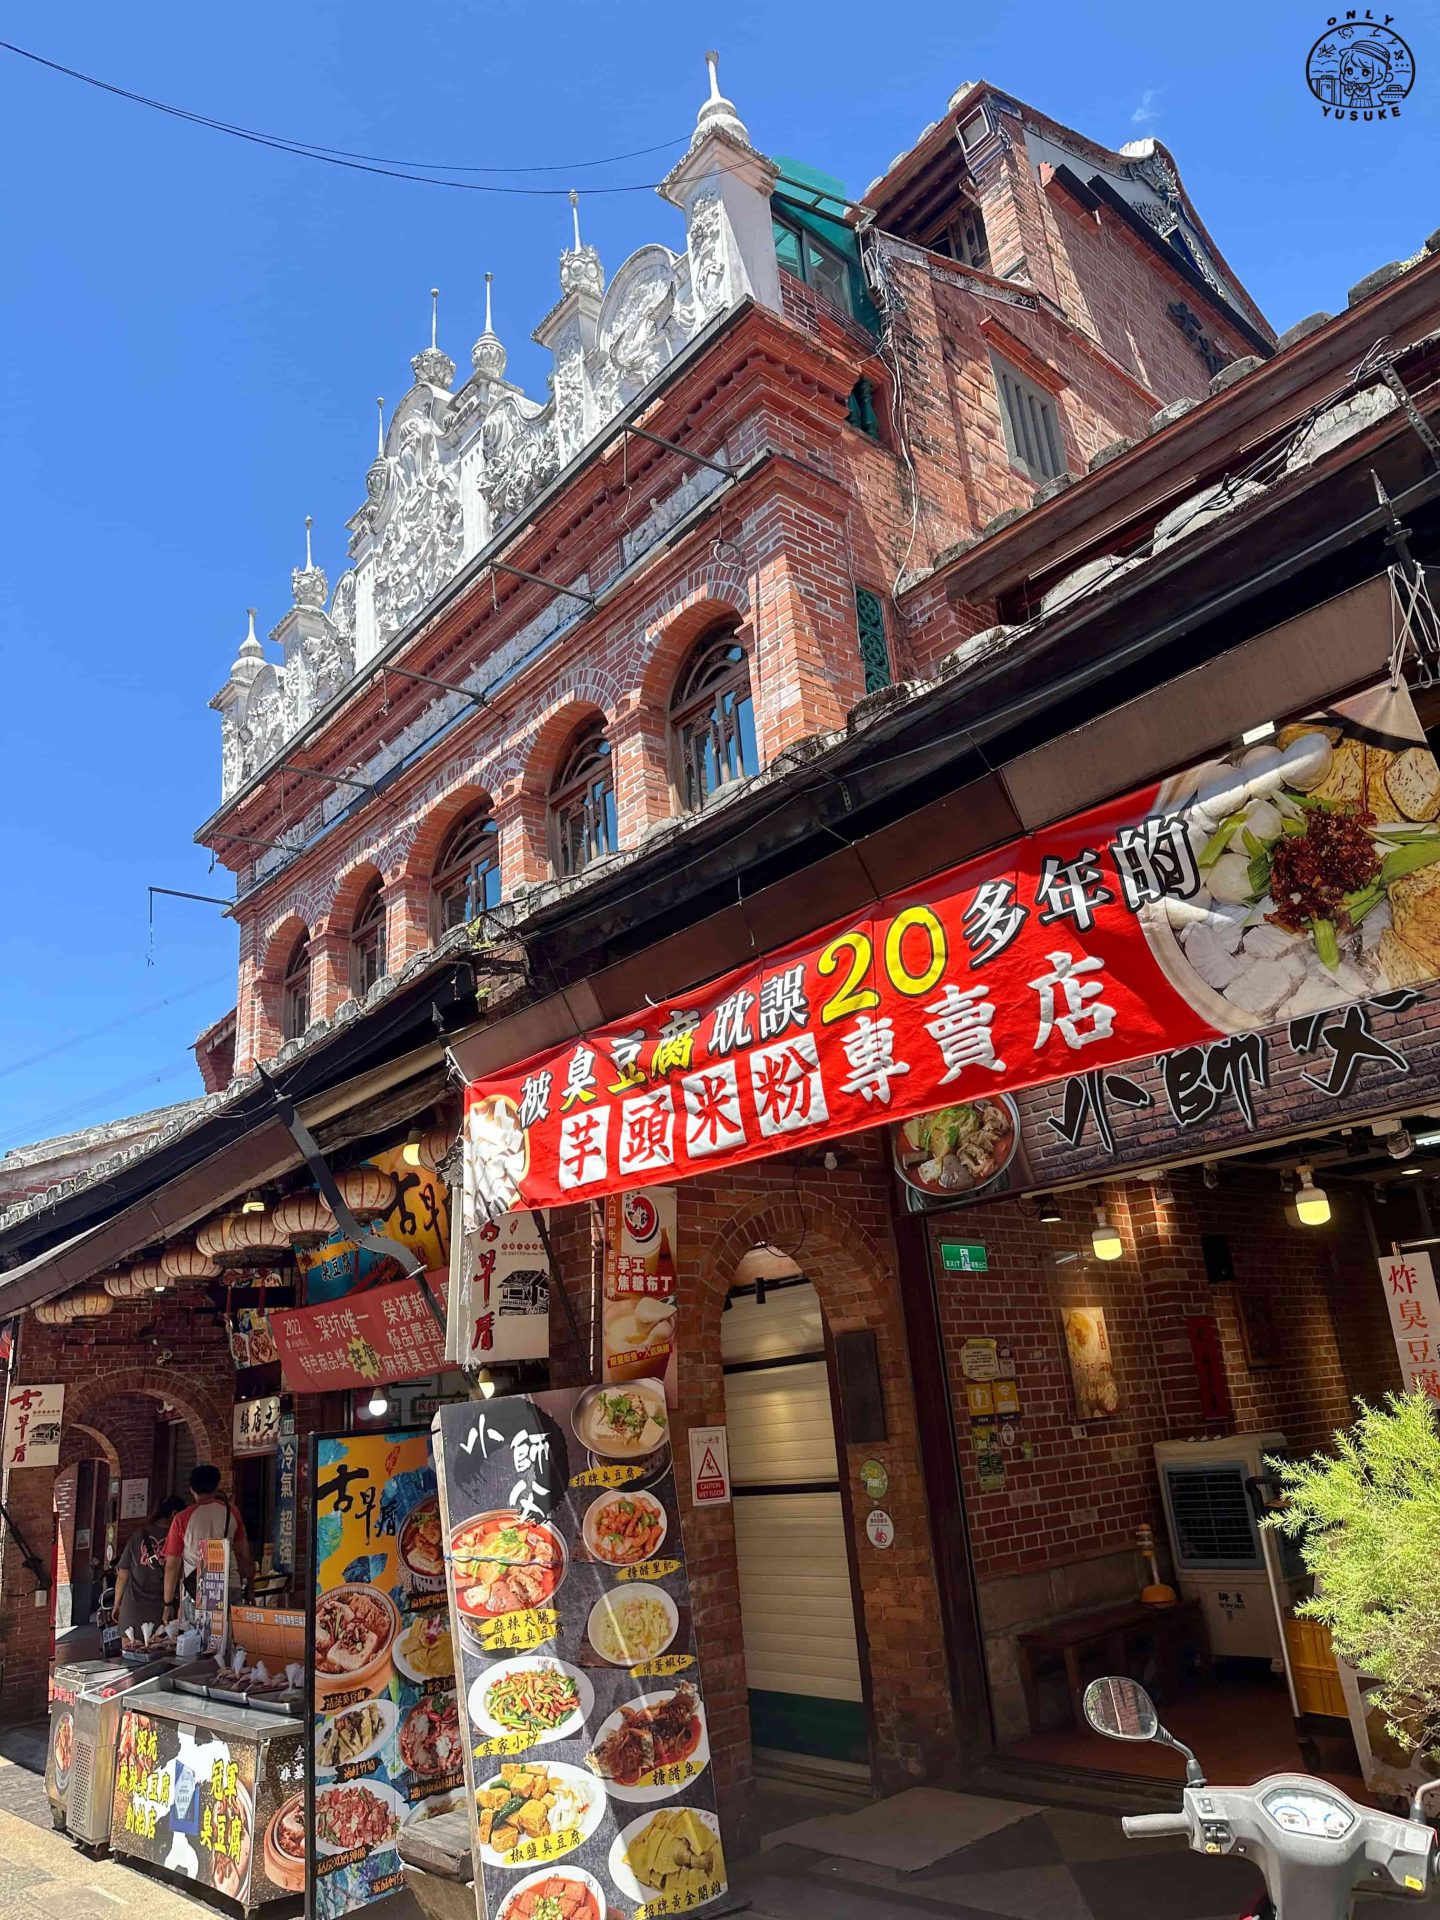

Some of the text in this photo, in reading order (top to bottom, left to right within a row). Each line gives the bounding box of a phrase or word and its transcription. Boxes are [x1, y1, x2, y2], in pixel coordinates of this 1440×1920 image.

[517, 813, 1201, 1130] 被臭豆腐耽誤20多年的
[560, 951, 1118, 1187] 芋頭米粉專賣店
[617, 1257, 645, 1274] 手工
[617, 1275, 672, 1291] 焦糖布丁
[313, 1308, 369, 1343] 深坑唯一
[299, 1348, 351, 1375] 特色商品獎
[459, 1413, 551, 1526] 小師父
[575, 1468, 637, 1487] 招牌臭豆腐
[698, 1488, 724, 1498] WET FLOOR
[700, 1482, 721, 1490] CAUTION
[279, 1443, 294, 1565] 冷氣 超強
[628, 1561, 674, 1579] 糖醋里肌
[493, 1611, 553, 1634] 麻辣大腸
[493, 1622, 565, 1648] 鴨血臭豆腐
[642, 1657, 688, 1676] 滑蛋蝦仁
[137, 1728, 158, 1761] 深坑
[482, 1732, 538, 1756] 客家小炒
[117, 1760, 171, 1808] 麻辣臭豆腐
[211, 1758, 239, 1806] 冠軍
[652, 1762, 698, 1787] 糖醋魚
[200, 1805, 242, 1866] 臭豆腐
[510, 1833, 581, 1863] 椒鹽臭豆腐
